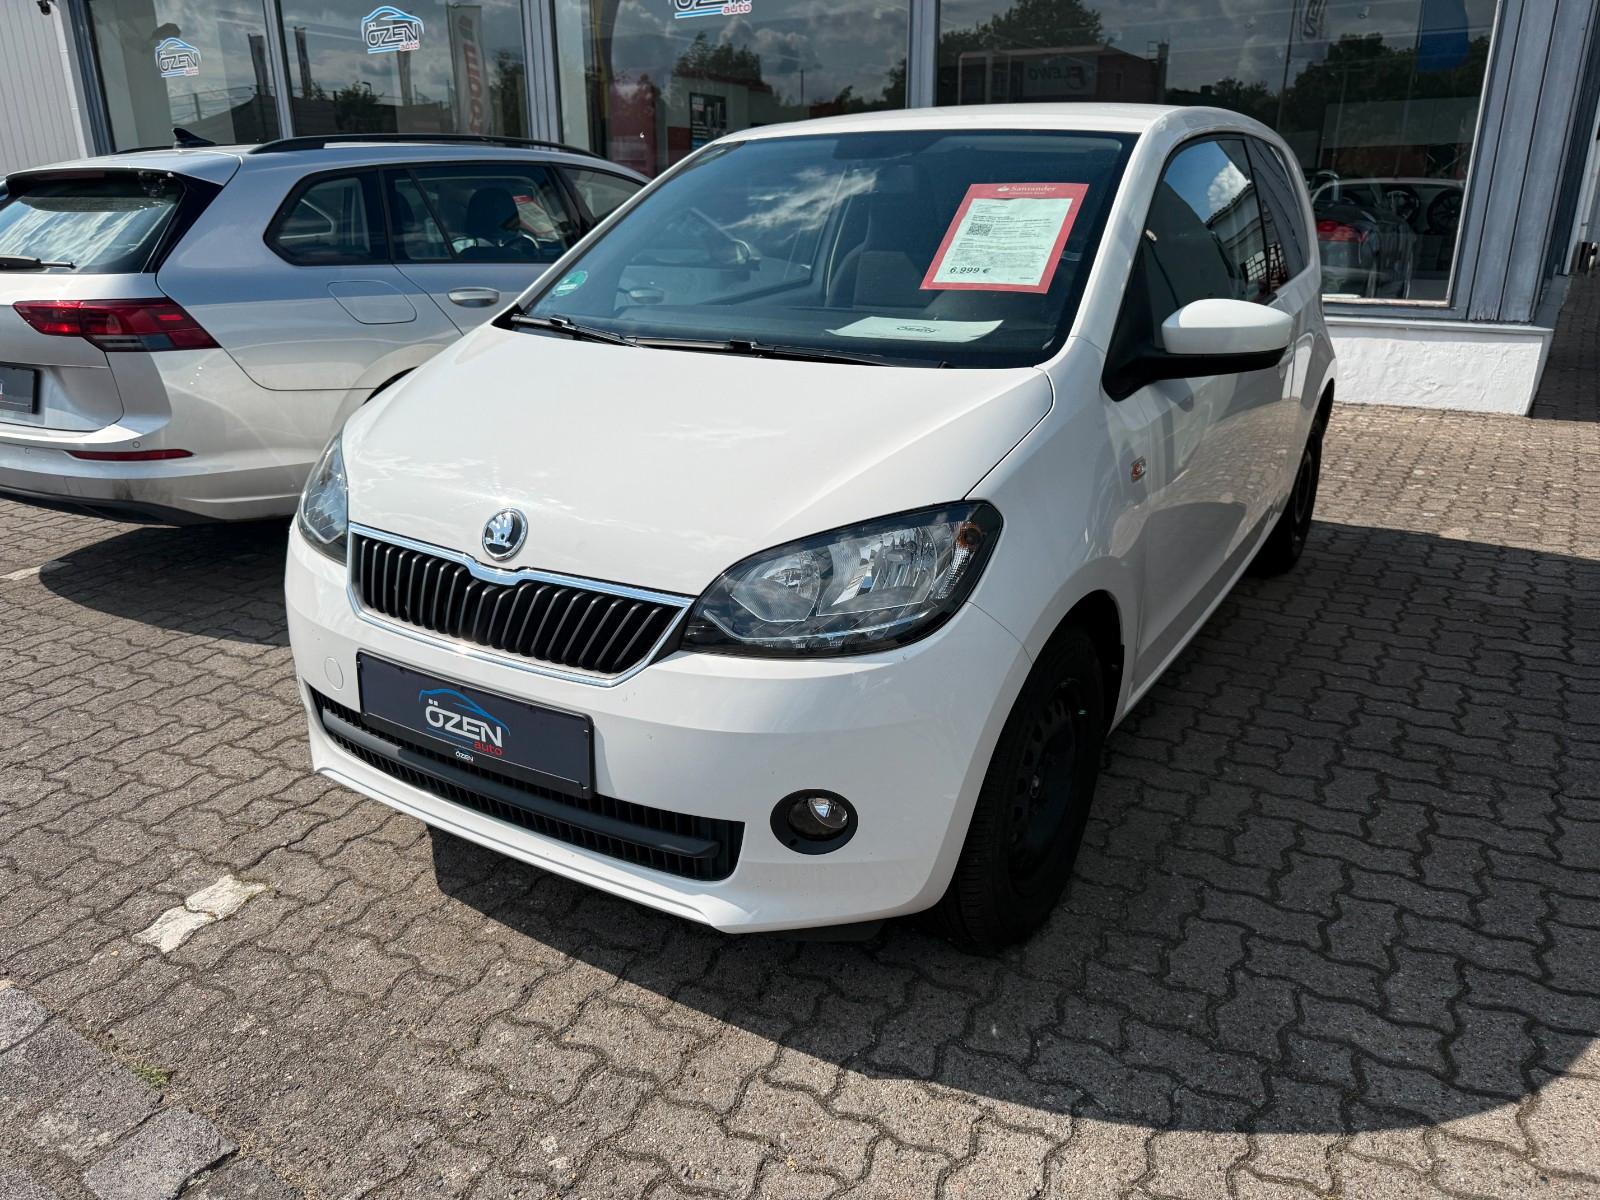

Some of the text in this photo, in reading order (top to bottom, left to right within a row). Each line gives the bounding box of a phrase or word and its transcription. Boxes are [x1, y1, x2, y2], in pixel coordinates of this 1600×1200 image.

[722, 3, 752, 15] auto
[366, 23, 419, 47] ÖZEN
[399, 41, 420, 51] auto
[160, 51, 198, 72] ÖZEN
[1010, 184, 1057, 192] Santander
[949, 266, 980, 274] 6.999
[425, 698, 503, 747] ÖZEN
[473, 740, 503, 756] auto
